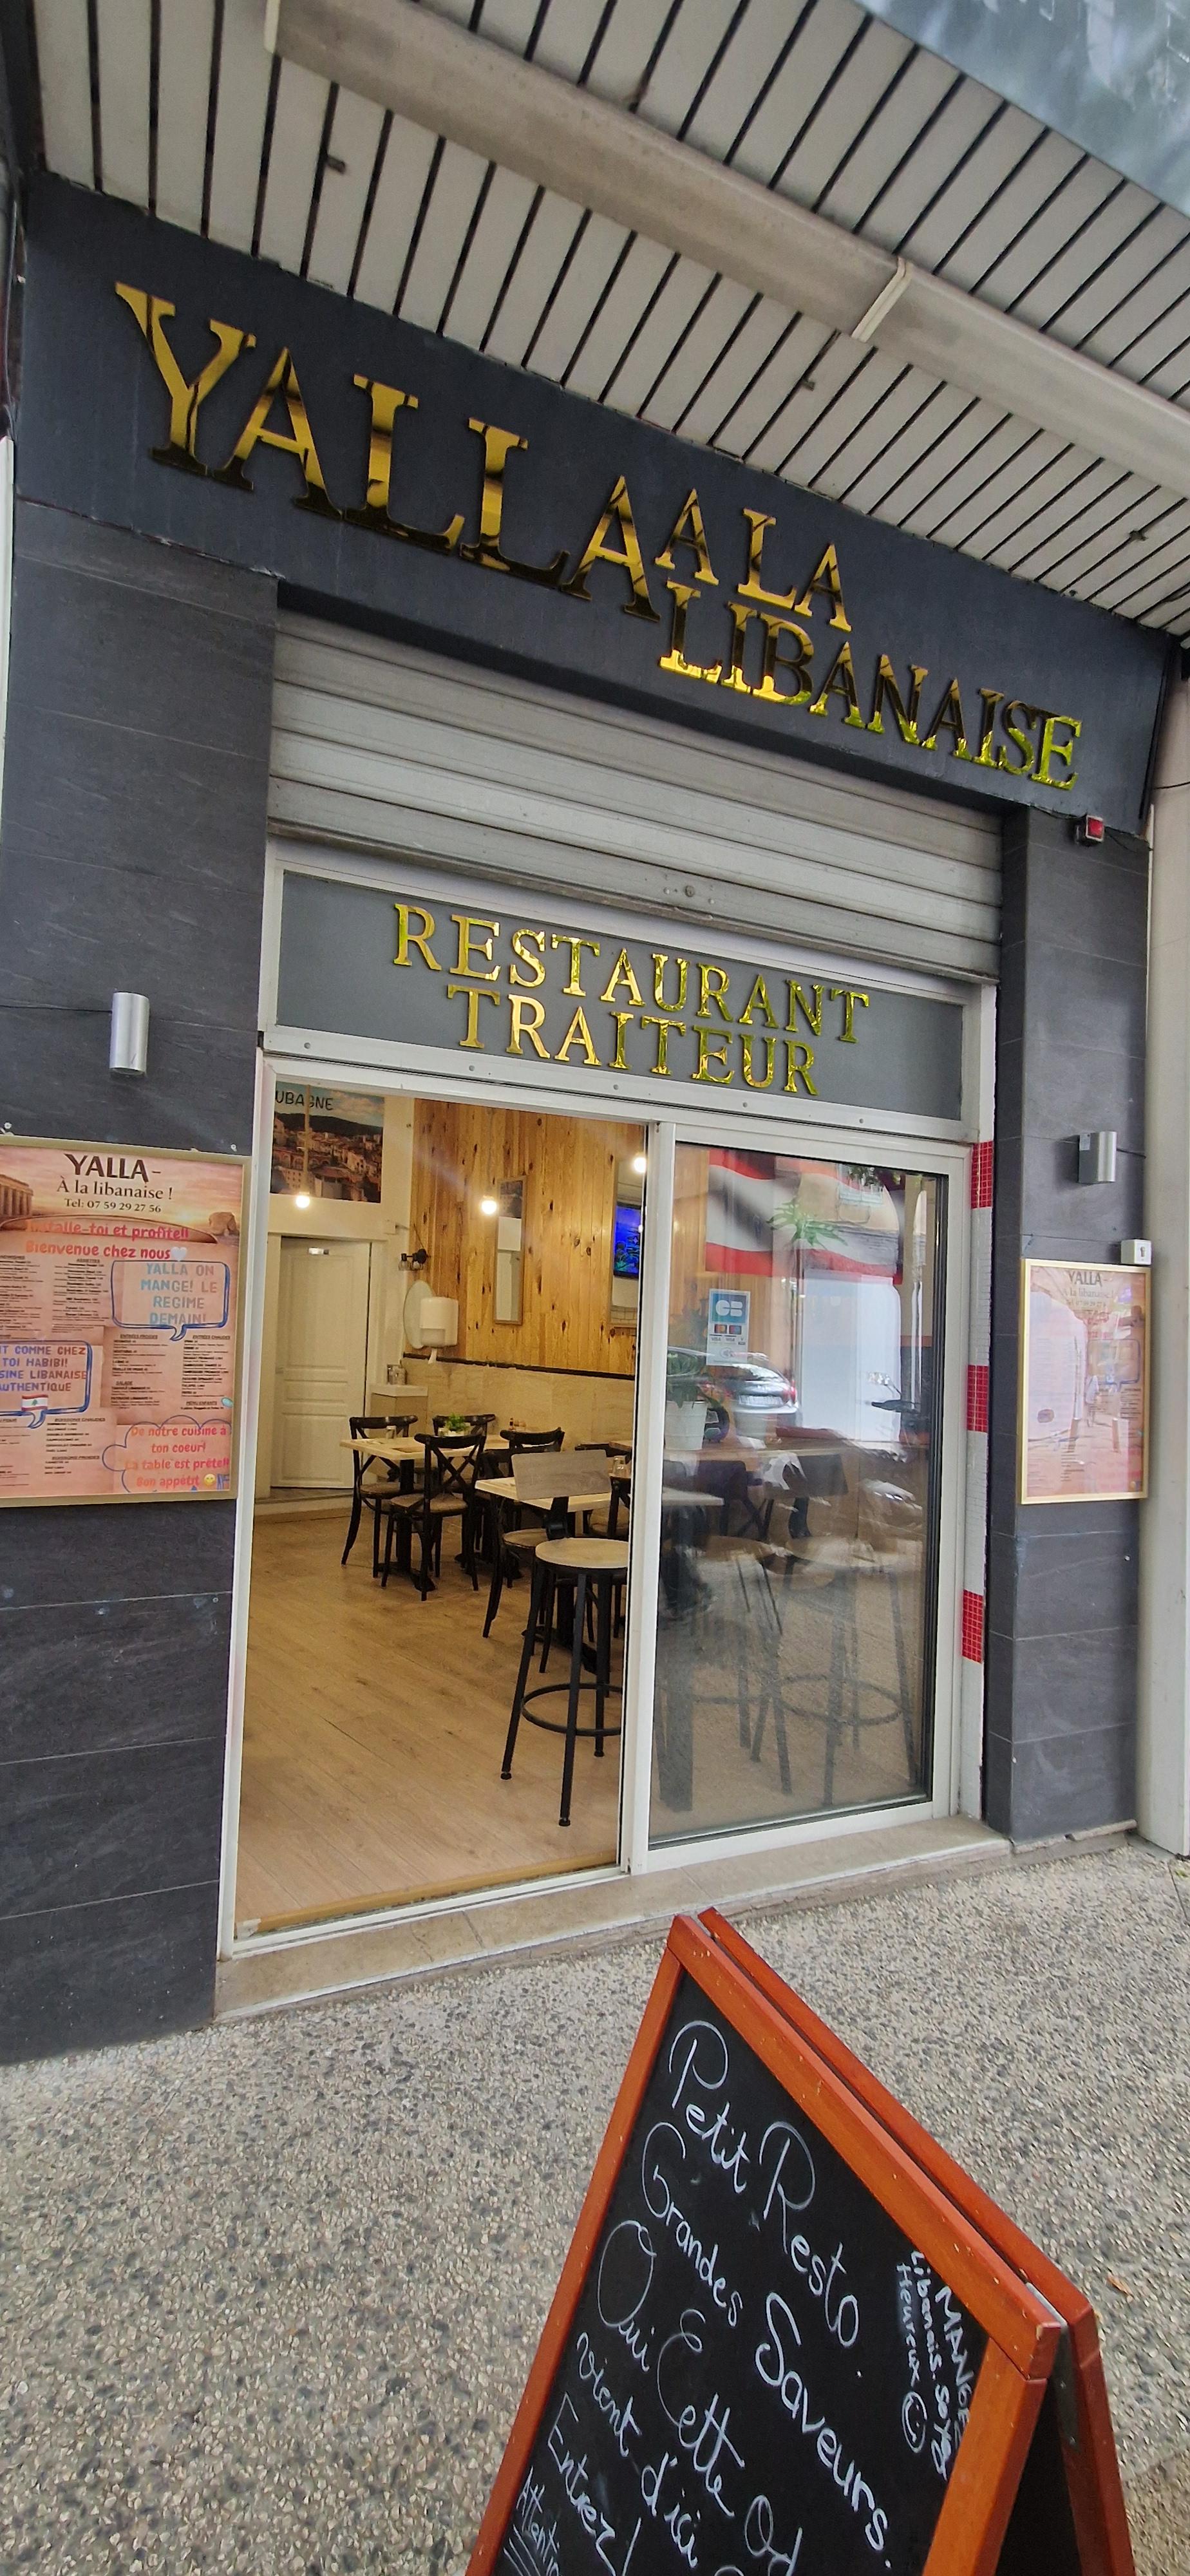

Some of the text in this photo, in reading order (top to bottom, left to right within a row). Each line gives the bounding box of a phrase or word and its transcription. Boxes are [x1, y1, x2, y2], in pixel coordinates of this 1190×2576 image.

[115, 281, 661, 622] YALLA
[654, 489, 853, 632] A LA
[659, 580, 1082, 791] LIBANAISE
[393, 904, 869, 1043] RESTAURANT
[447, 984, 819, 1095] TRAITEUR
[64, 1153, 149, 1182] YALLA
[57, 1175, 70, 1192] À
[75, 1180, 88, 1194] la
[94, 1180, 164, 1200] libanaise
[64, 1198, 84, 1208] Tel:
[149, 1204, 161, 1213] 56
[113, 1225, 127, 1236] et
[26, 1240, 170, 1260] Bienvenue chez nous
[146, 1263, 214, 1276] YALLA ON
[140, 1280, 217, 1293] MANGE! LE
[149, 1312, 206, 1325] DEMAIN!
[15, 1346, 52, 1354] COMME
[57, 1347, 86, 1355] CHEZ
[3, 1358, 68, 1367] TOI HABIBI!
[30, 1370, 88, 1379] LIBANAISE
[148, 1426, 178, 1436] notre
[182, 1426, 217, 1436] cuisine
[151, 1444, 169, 1454] ton
[142, 1459, 171, 1470] table
[175, 1460, 191, 1468] est
[136, 1477, 156, 1488] Bon
[668, 2020, 750, 2193] Petit
[643, 2122, 742, 2327] Grandes
[577, 2332, 642, 2457] vient
